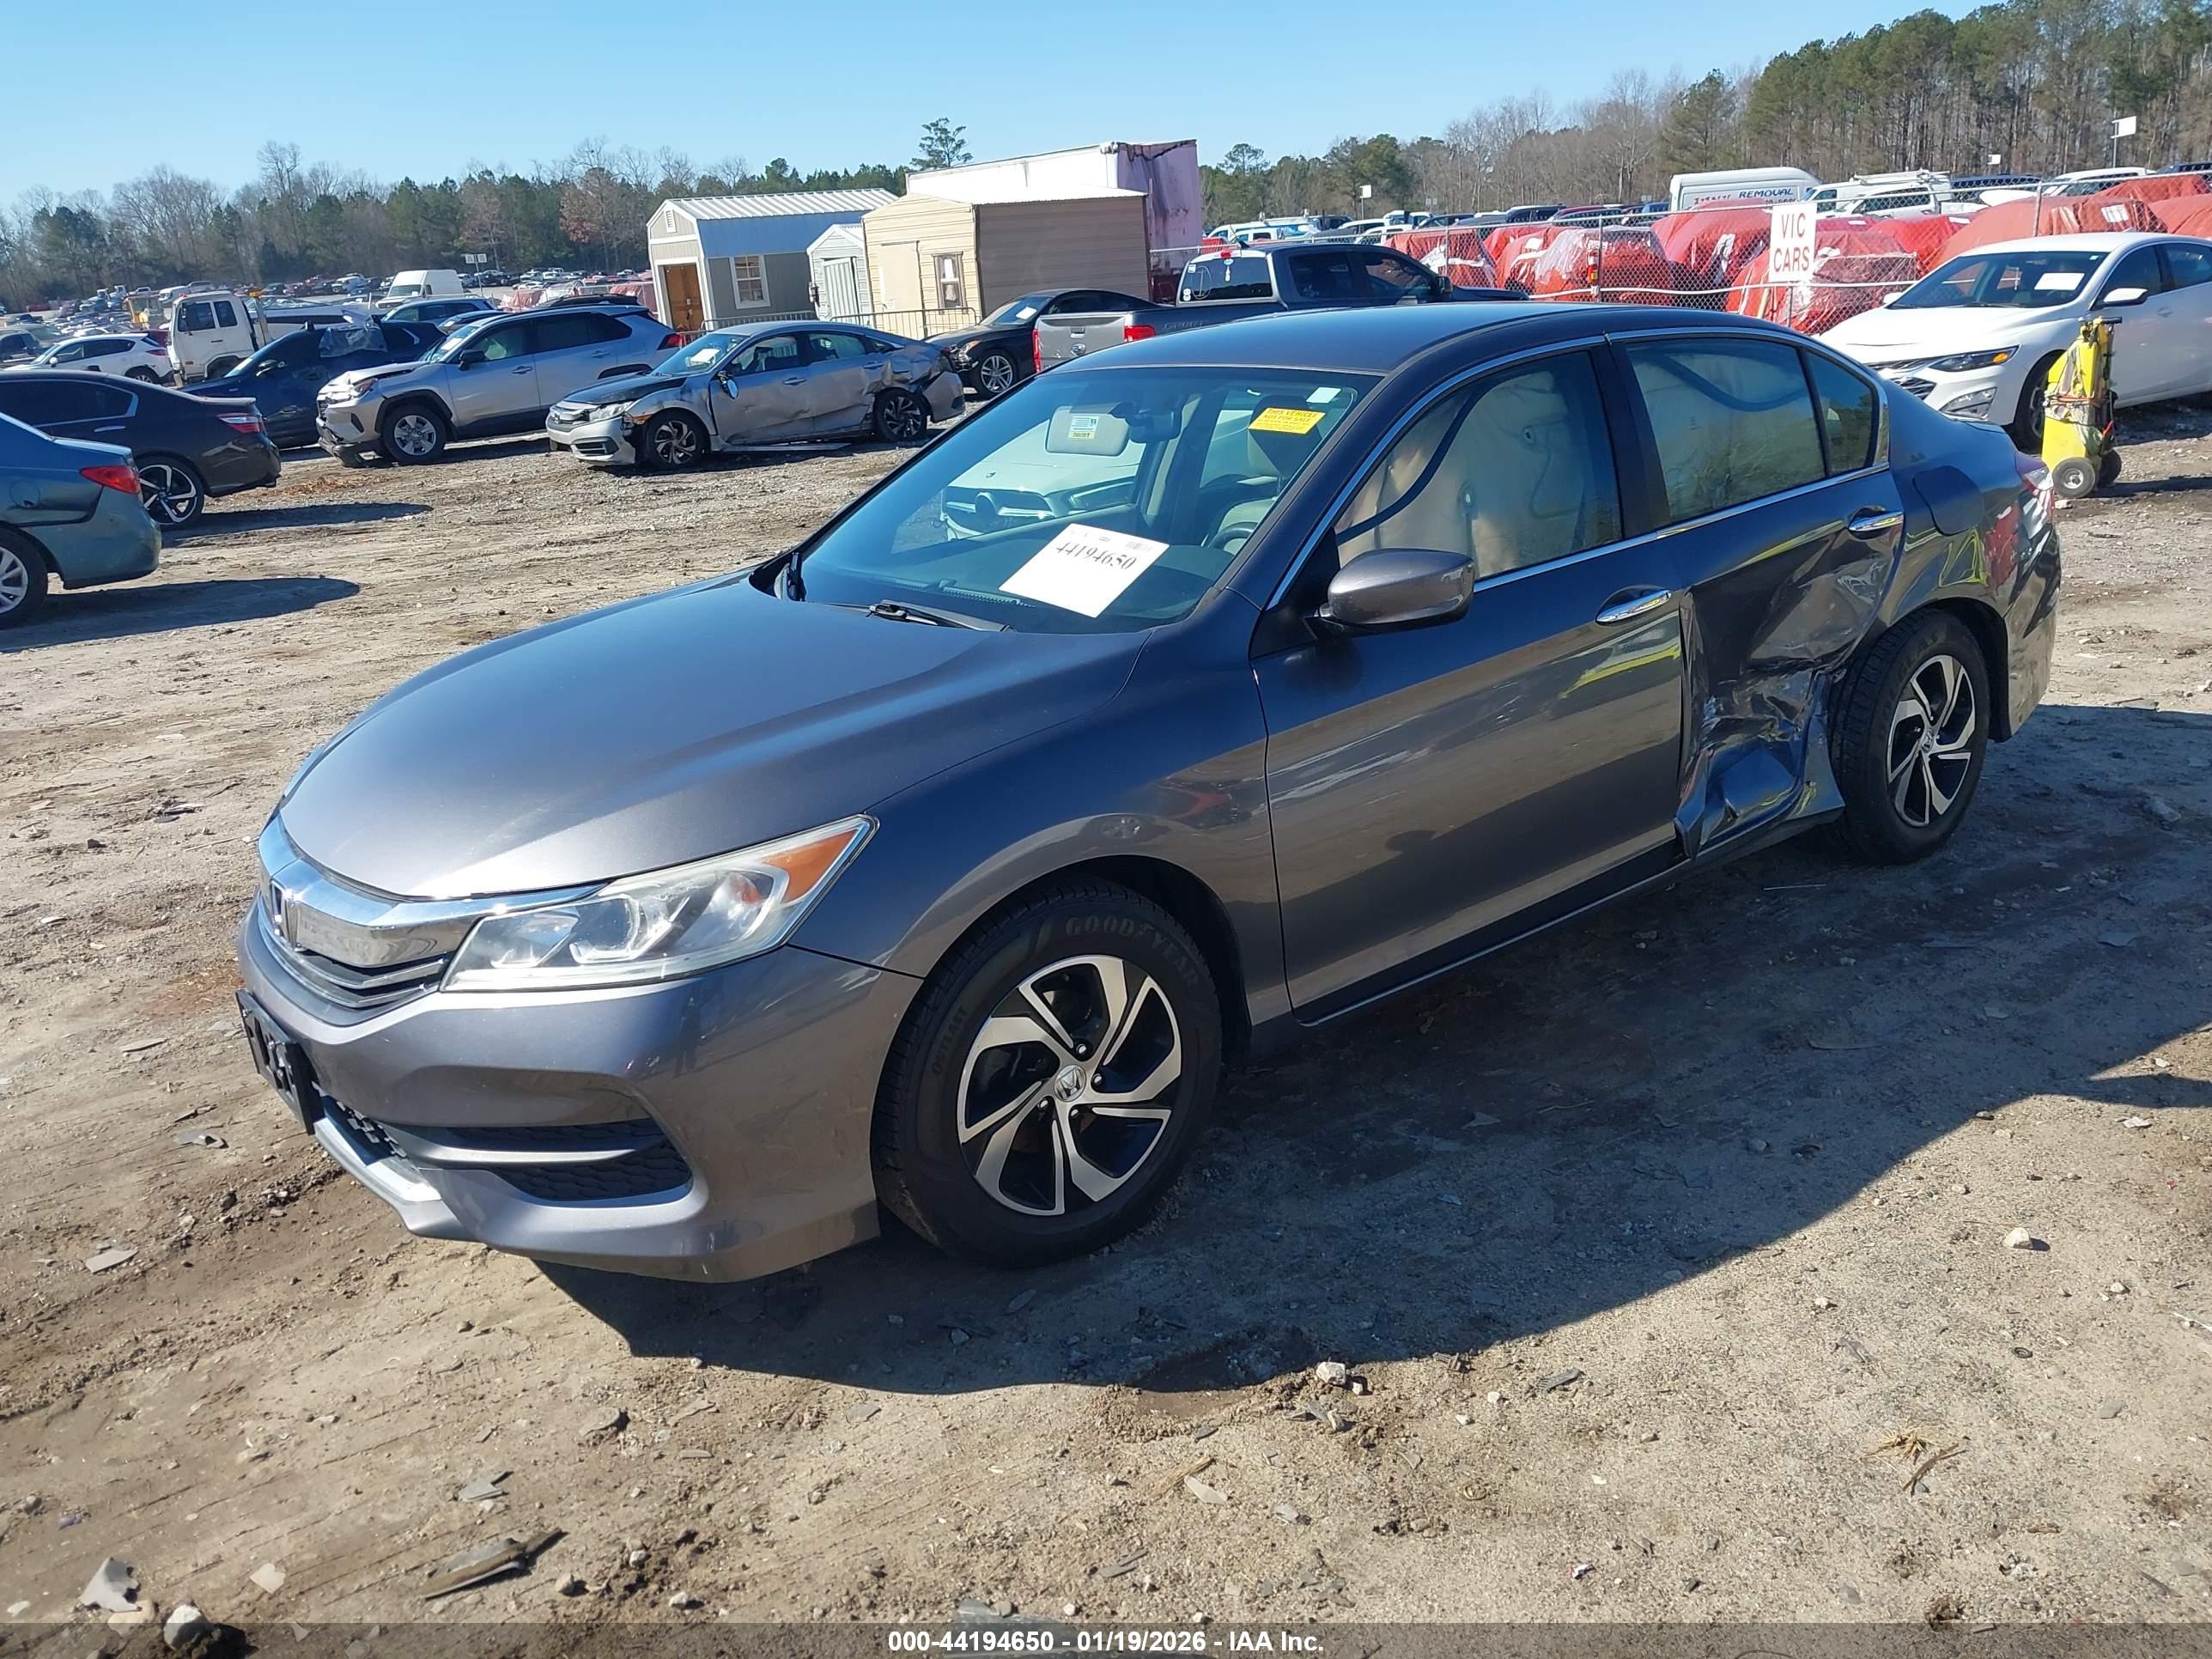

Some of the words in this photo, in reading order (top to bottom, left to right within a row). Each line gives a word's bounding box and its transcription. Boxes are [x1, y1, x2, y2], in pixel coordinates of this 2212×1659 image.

[1739, 188, 1794, 198] REMOVAL
[1781, 212, 1806, 239] VIC
[1773, 246, 1810, 272] CARS
[1057, 542, 1137, 570] 44194650
[1065, 915, 1200, 985] GOODYEAR
